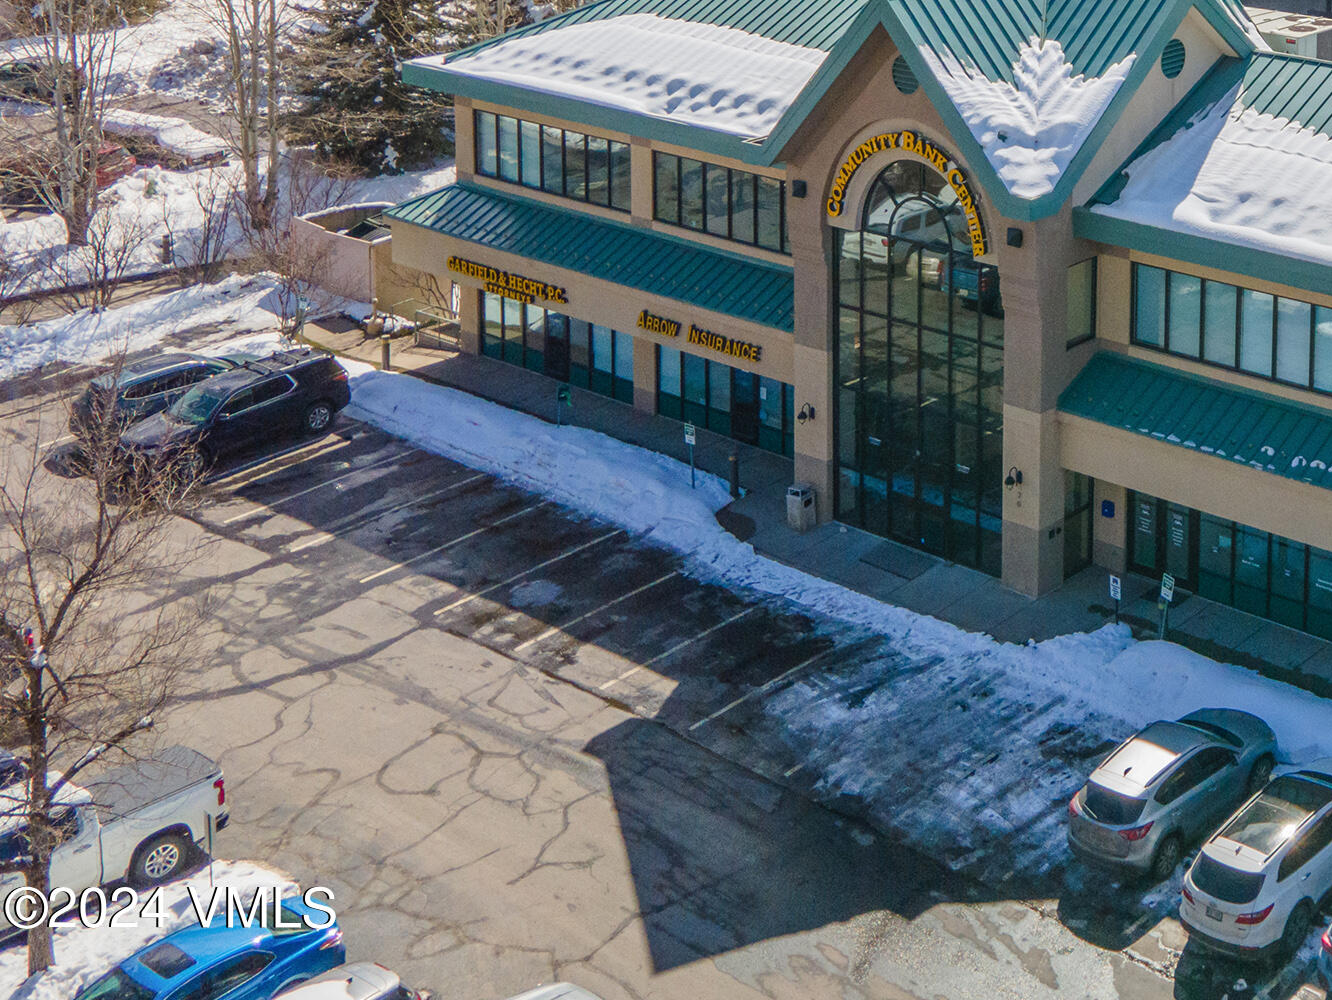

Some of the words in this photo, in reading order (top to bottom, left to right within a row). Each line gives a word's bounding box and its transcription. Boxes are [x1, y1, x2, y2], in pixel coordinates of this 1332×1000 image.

[827, 132, 899, 218] COMMUNITY
[901, 130, 949, 174] BANK
[947, 167, 985, 258] CENTER
[446, 255, 499, 284] GARFIELD
[498, 272, 508, 288] &
[547, 285, 567, 305] P.C.
[483, 282, 532, 305] ATTORNEYS
[637, 310, 679, 338] ARROW
[687, 324, 760, 362] INSURANCE
